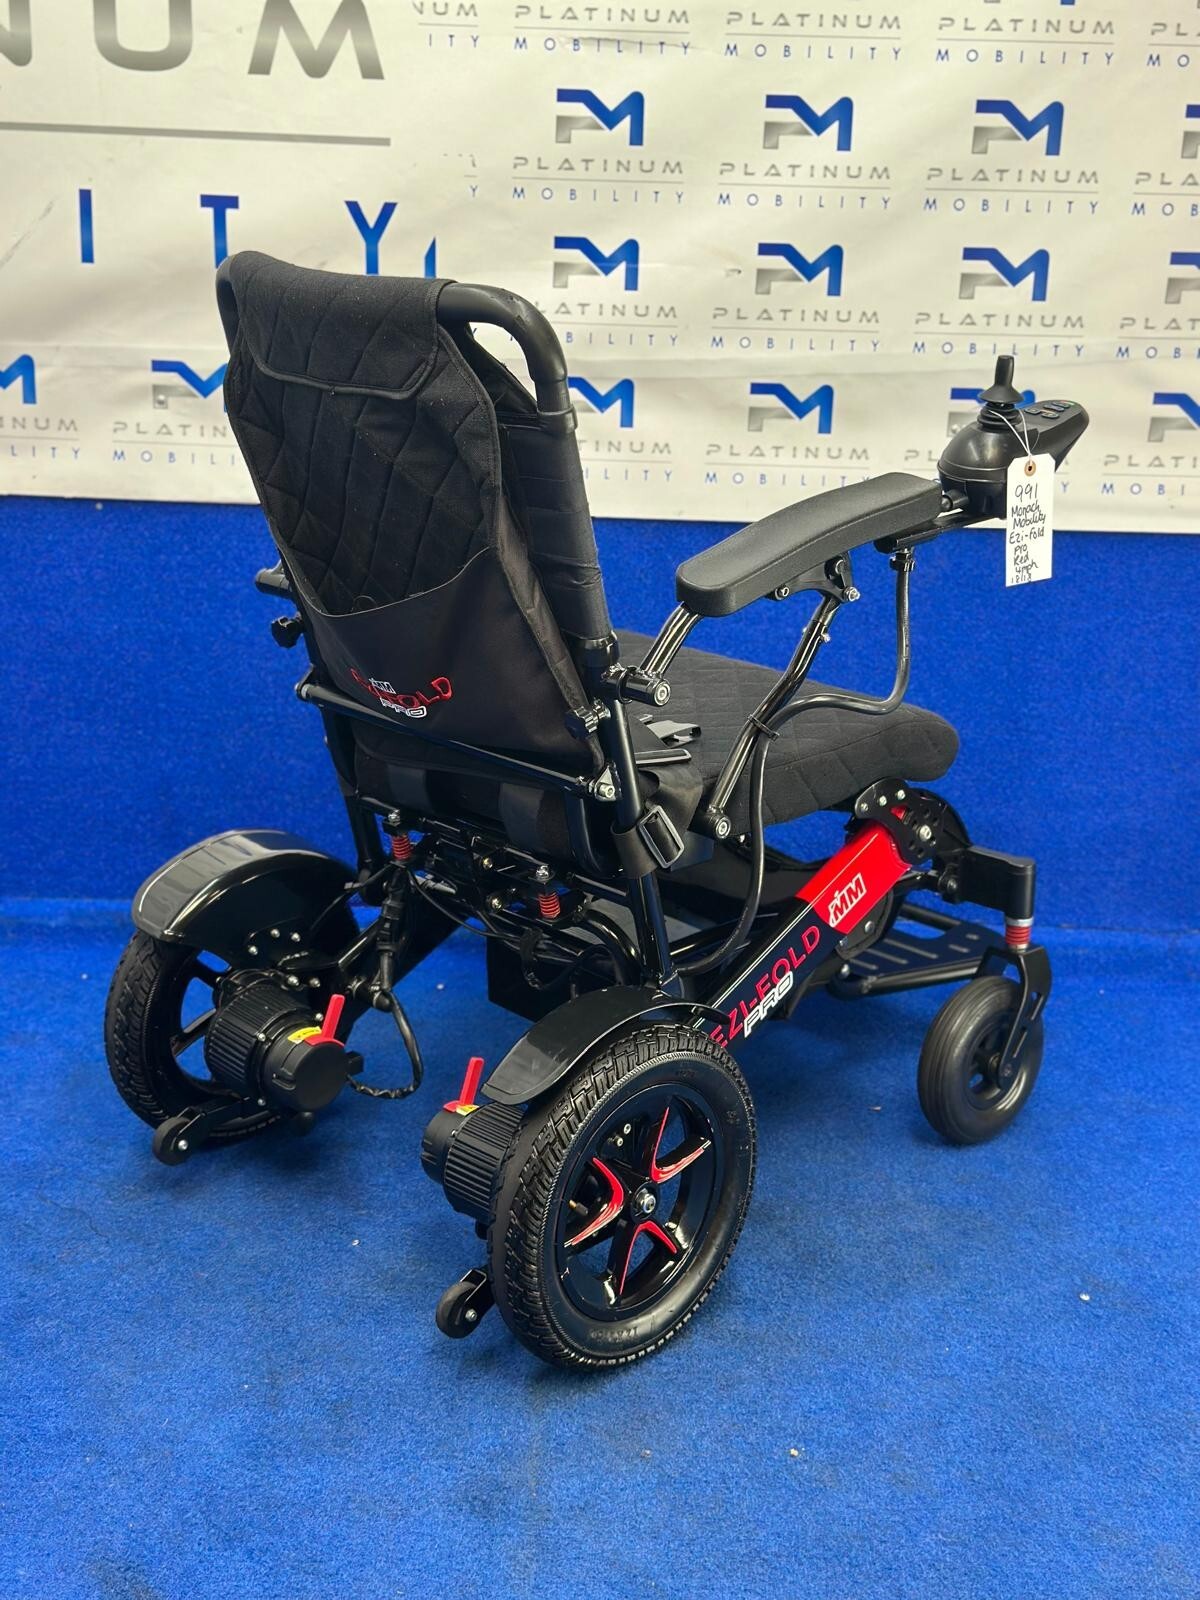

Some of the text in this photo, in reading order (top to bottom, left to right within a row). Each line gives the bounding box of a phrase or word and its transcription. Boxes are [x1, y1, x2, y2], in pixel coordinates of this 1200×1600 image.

[515, 5, 690, 24] PLATINUM
[726, 11, 900, 29] PLATINUM
[938, 17, 1115, 35] PLATINUM
[1151, 22, 1200, 37] PL
[514, 36, 690, 55] MOBILITY
[724, 43, 901, 60] MOBILITY
[936, 49, 1114, 65] MOBILITY
[513, 157, 683, 174] PLATINUM
[719, 162, 890, 180] PLATINUM
[927, 168, 1098, 184] PLATINUM
[513, 186, 683, 203] MOBILITY
[718, 192, 890, 209] MOBILITY
[923, 197, 1098, 214] MOBILITY
[713, 307, 879, 323] PLATINUM
[915, 312, 1084, 328] PLATINUM
[711, 336, 880, 352] MOBILITY
[913, 341, 1084, 357] MOBILITY
[706, 444, 869, 460] PLATINUM
[1014, 483, 1038, 502] 991
[710, 925, 821, 1048] EZI-FOLD
[744, 971, 794, 1038] PRO
